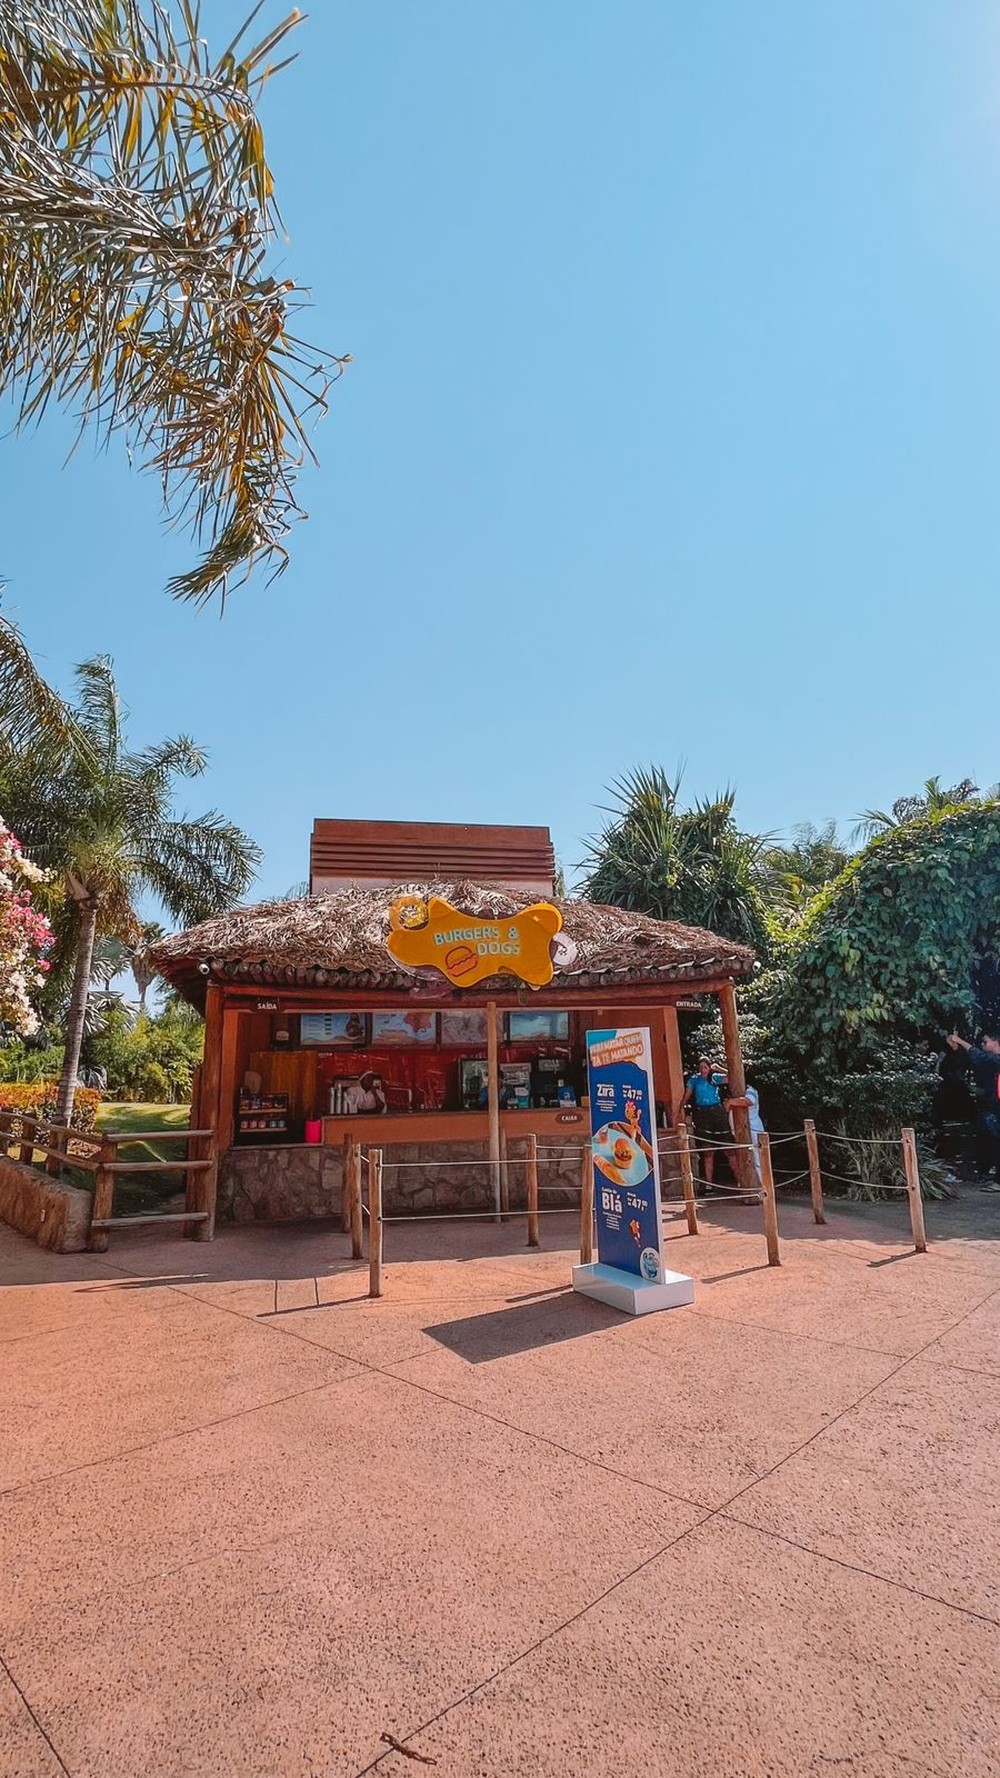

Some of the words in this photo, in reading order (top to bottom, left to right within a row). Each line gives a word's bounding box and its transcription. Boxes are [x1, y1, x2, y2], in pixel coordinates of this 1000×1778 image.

[434, 926, 499, 945] BURGERS
[508, 926, 519, 939] &
[477, 942, 520, 955] DOGS
[257, 1001, 277, 1010] SAÍDA
[610, 1044, 643, 1061] MATANDO
[597, 1086, 614, 1097] Zira
[602, 1192, 622, 1213] Blá
